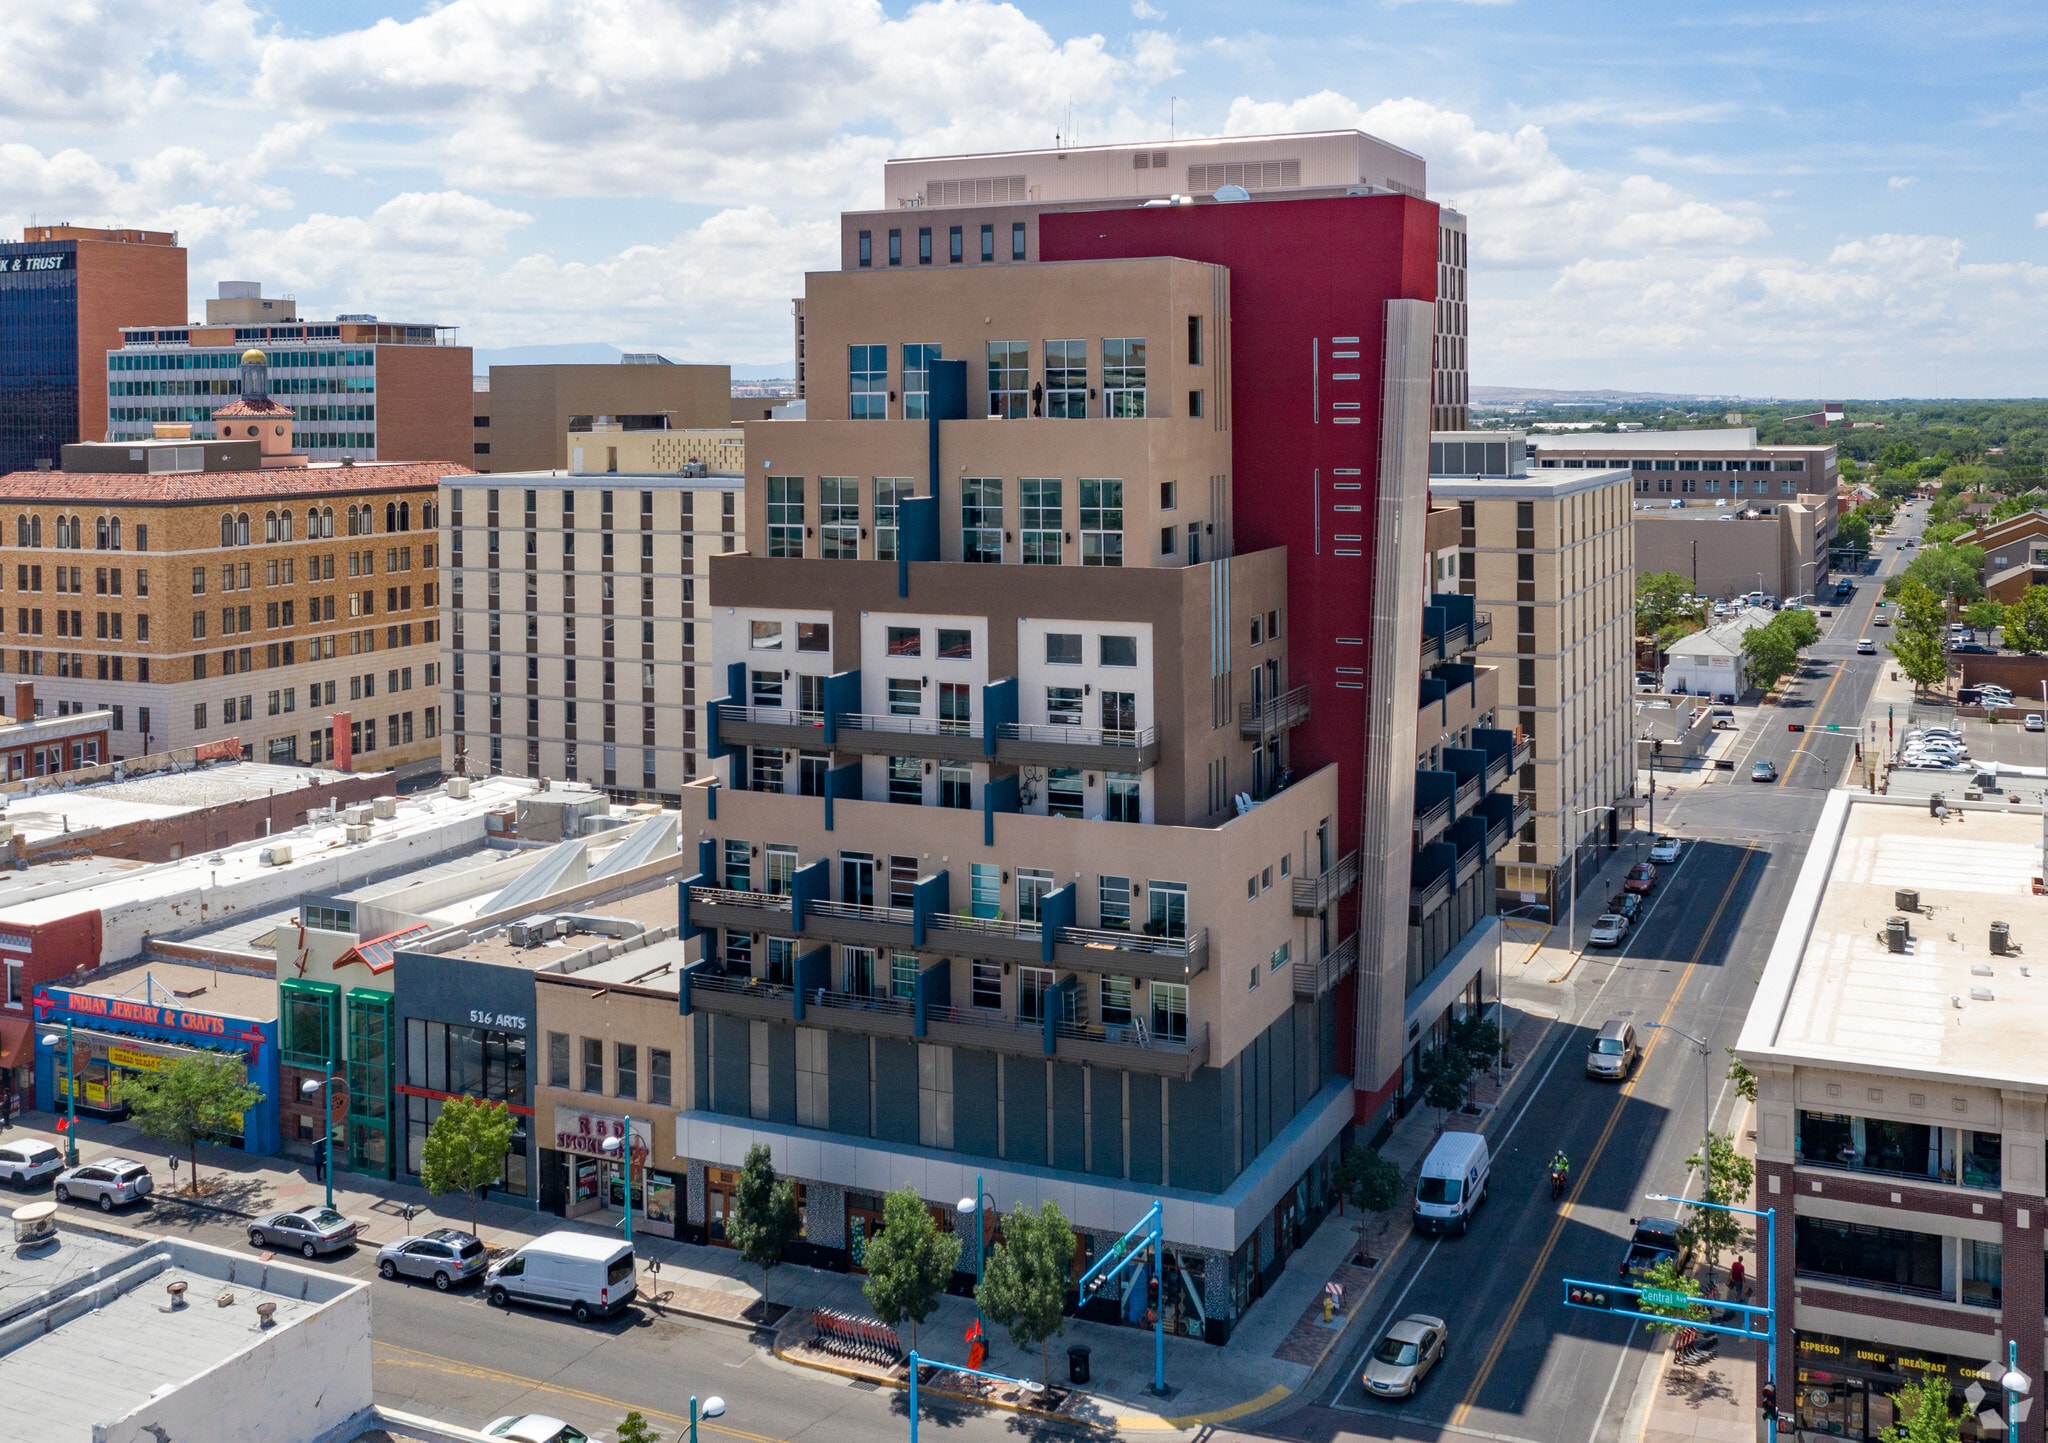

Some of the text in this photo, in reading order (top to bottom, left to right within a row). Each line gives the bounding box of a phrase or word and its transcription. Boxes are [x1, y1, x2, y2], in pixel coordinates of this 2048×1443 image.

[12, 258, 21, 271] &
[26, 256, 63, 271] TRUST
[68, 993, 225, 1034] INDIAN JEWELRY & CRAFTS
[470, 1010, 527, 1029] 516 ARTS
[557, 1132, 605, 1155] SMOKE
[1642, 1289, 1687, 1304] Central Ave
[1800, 1340, 1840, 1355] ESPRESSO
[1857, 1350, 1886, 1363] LUNCH
[1960, 1368, 1992, 1381] COFFEE
